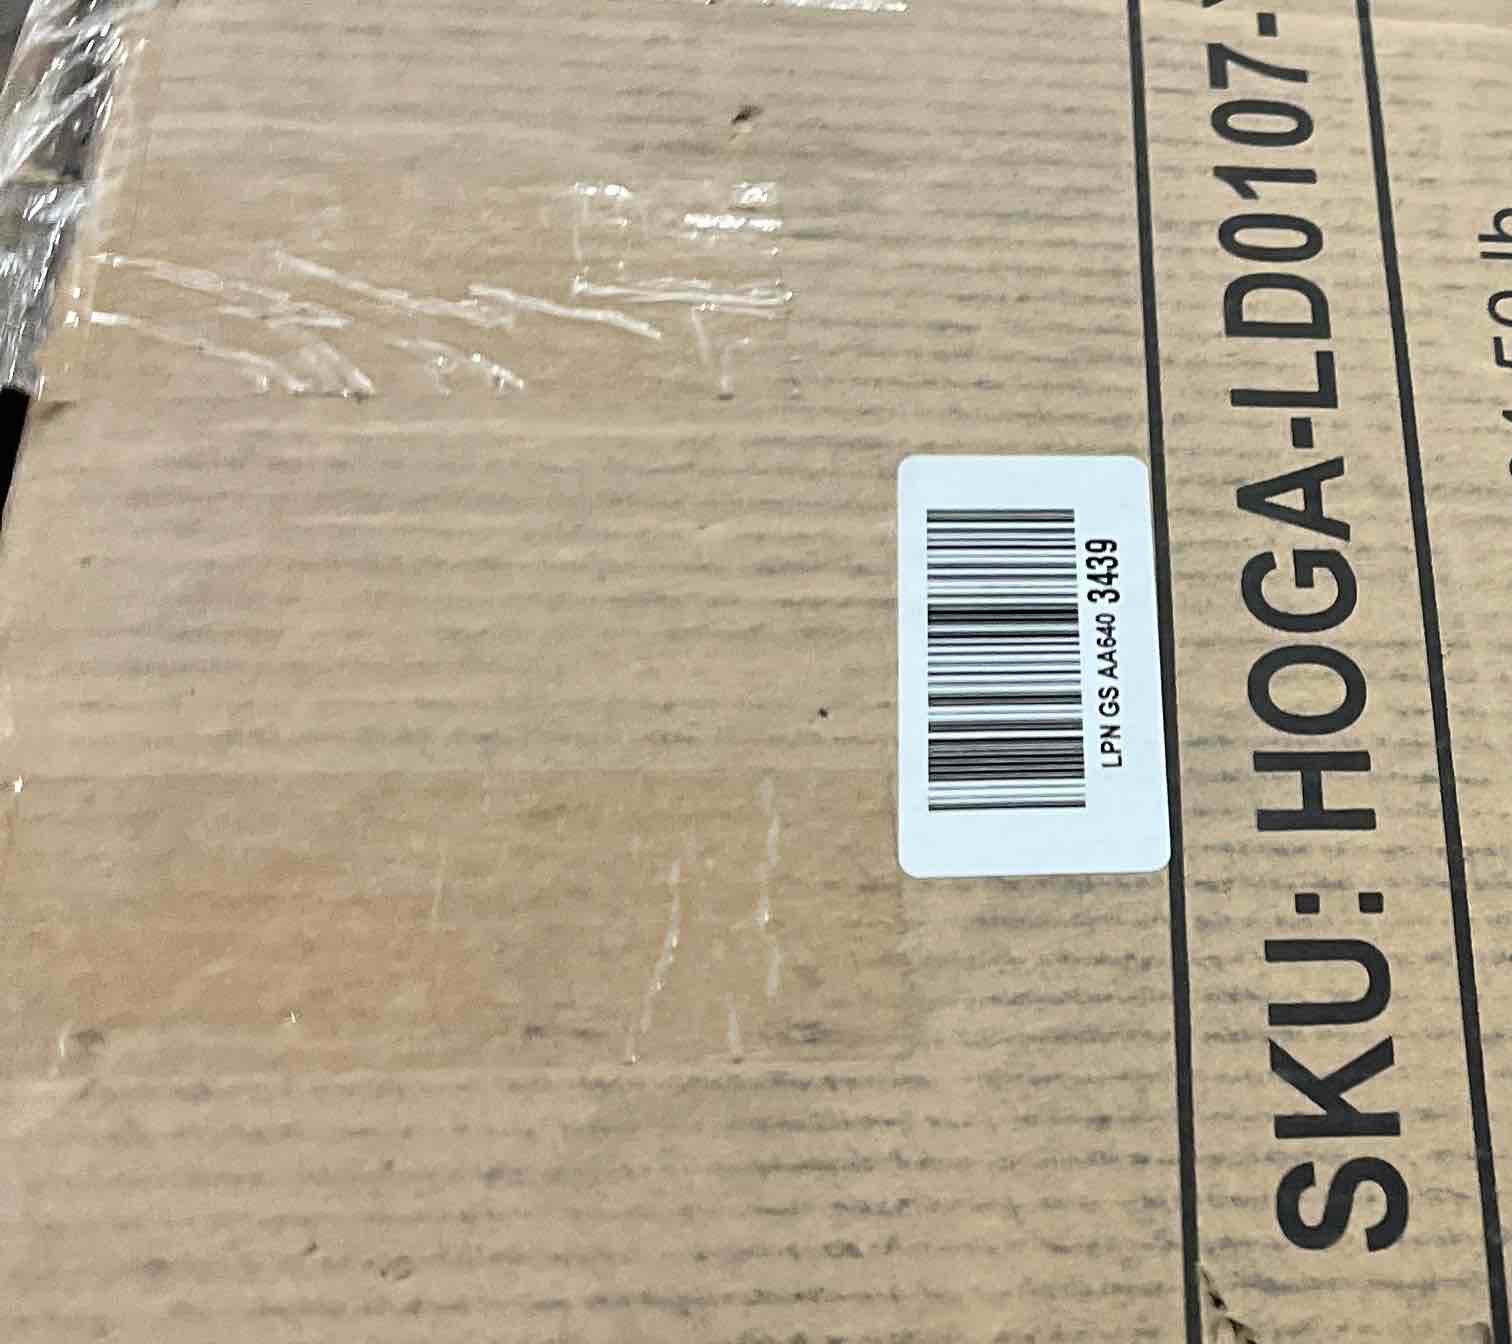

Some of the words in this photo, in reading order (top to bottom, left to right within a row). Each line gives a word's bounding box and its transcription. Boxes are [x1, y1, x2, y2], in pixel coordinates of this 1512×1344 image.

[1085, 538, 1121, 605] 3439
[1094, 612, 1119, 680] AA640
[1097, 686, 1121, 718] GS
[1100, 724, 1123, 769] LPN
[1264, 892, 1408, 1252] SKU:
